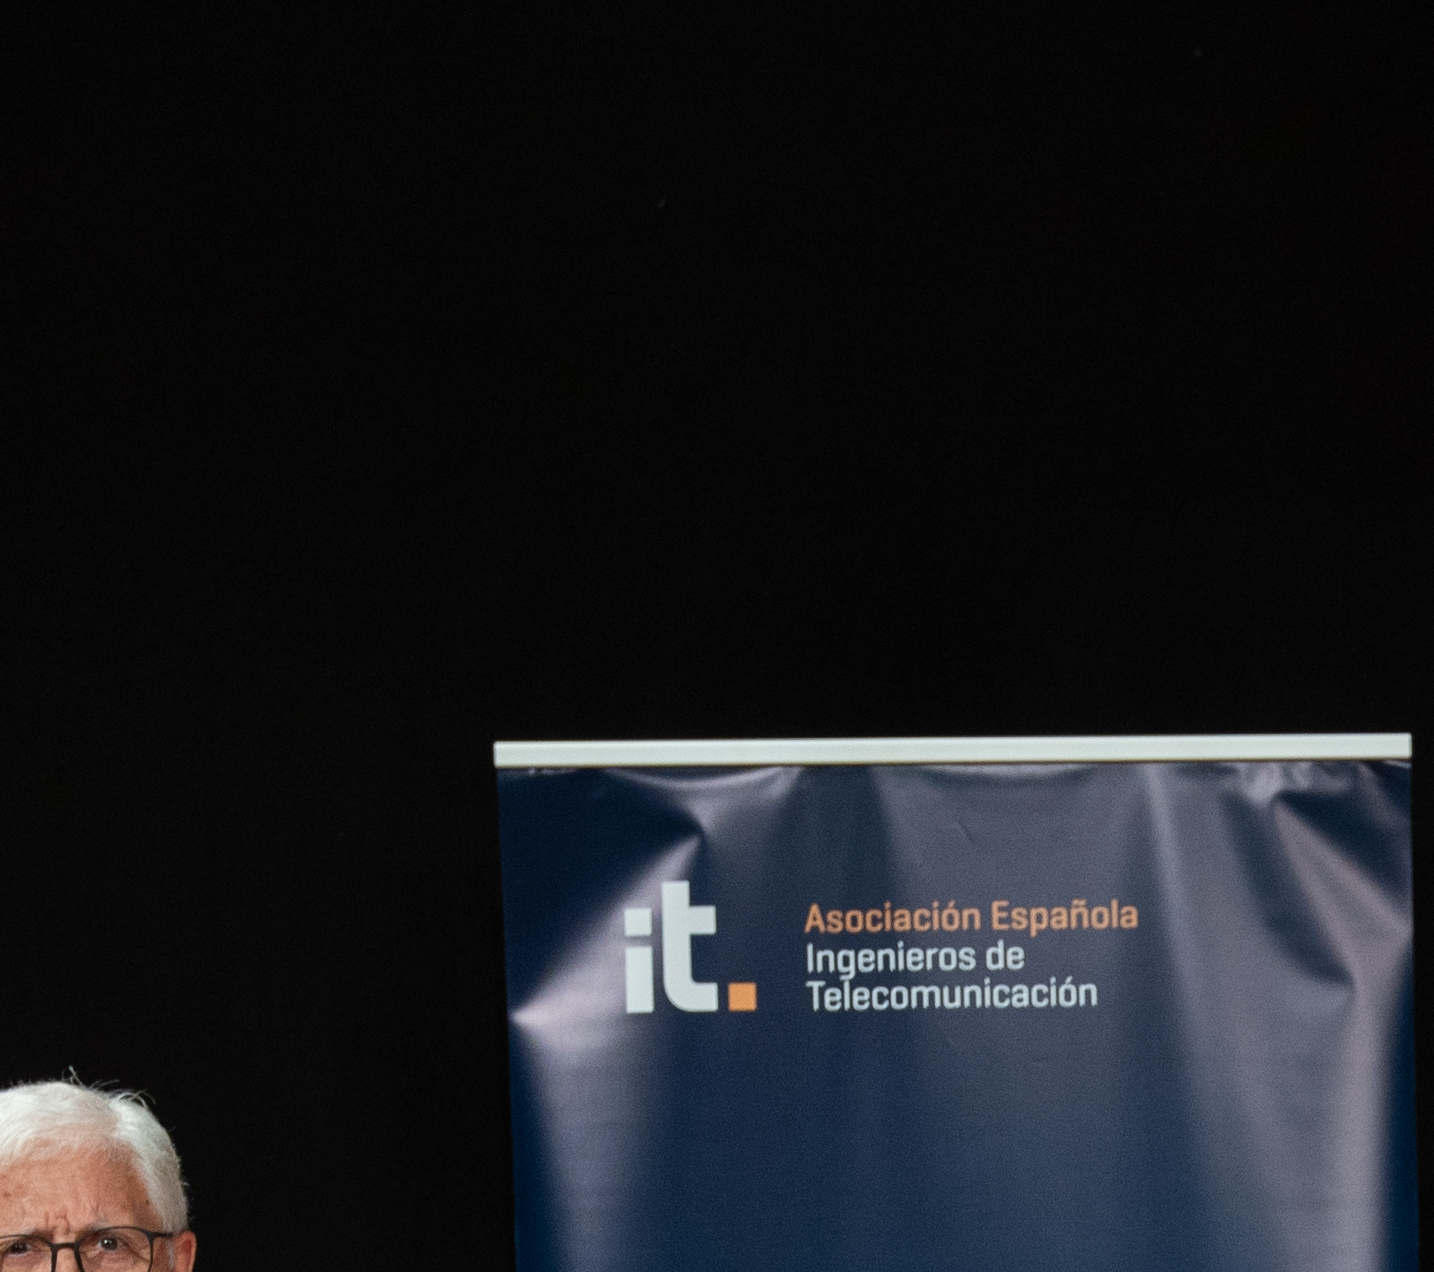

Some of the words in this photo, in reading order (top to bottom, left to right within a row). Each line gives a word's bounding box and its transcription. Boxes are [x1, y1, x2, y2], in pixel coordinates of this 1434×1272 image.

[804, 900, 982, 936] Asociación
[991, 897, 1139, 938] Española
[805, 941, 978, 981] Ingenieros
[986, 939, 1025, 973] de
[805, 975, 1097, 1014] Telecomunicación
